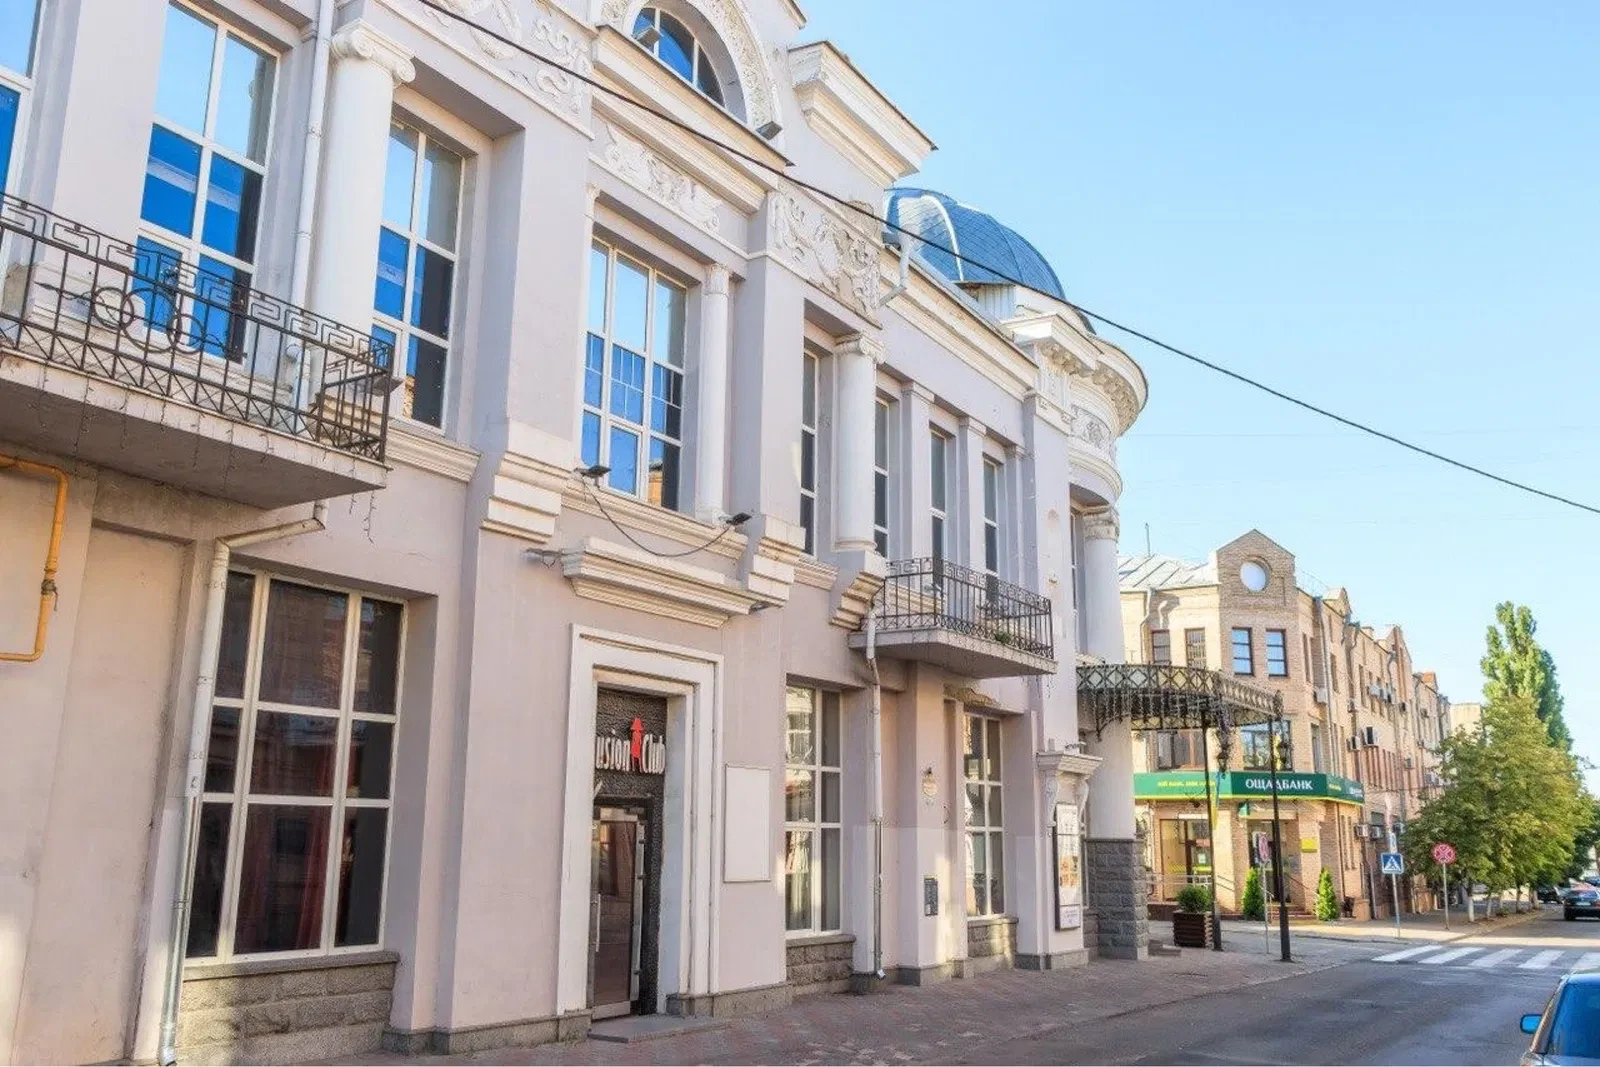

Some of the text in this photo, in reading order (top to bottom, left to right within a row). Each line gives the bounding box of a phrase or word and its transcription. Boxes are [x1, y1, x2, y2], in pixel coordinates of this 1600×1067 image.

[596, 729, 666, 774] usion Club
[1245, 778, 1313, 790] ОЩАДБАНК
